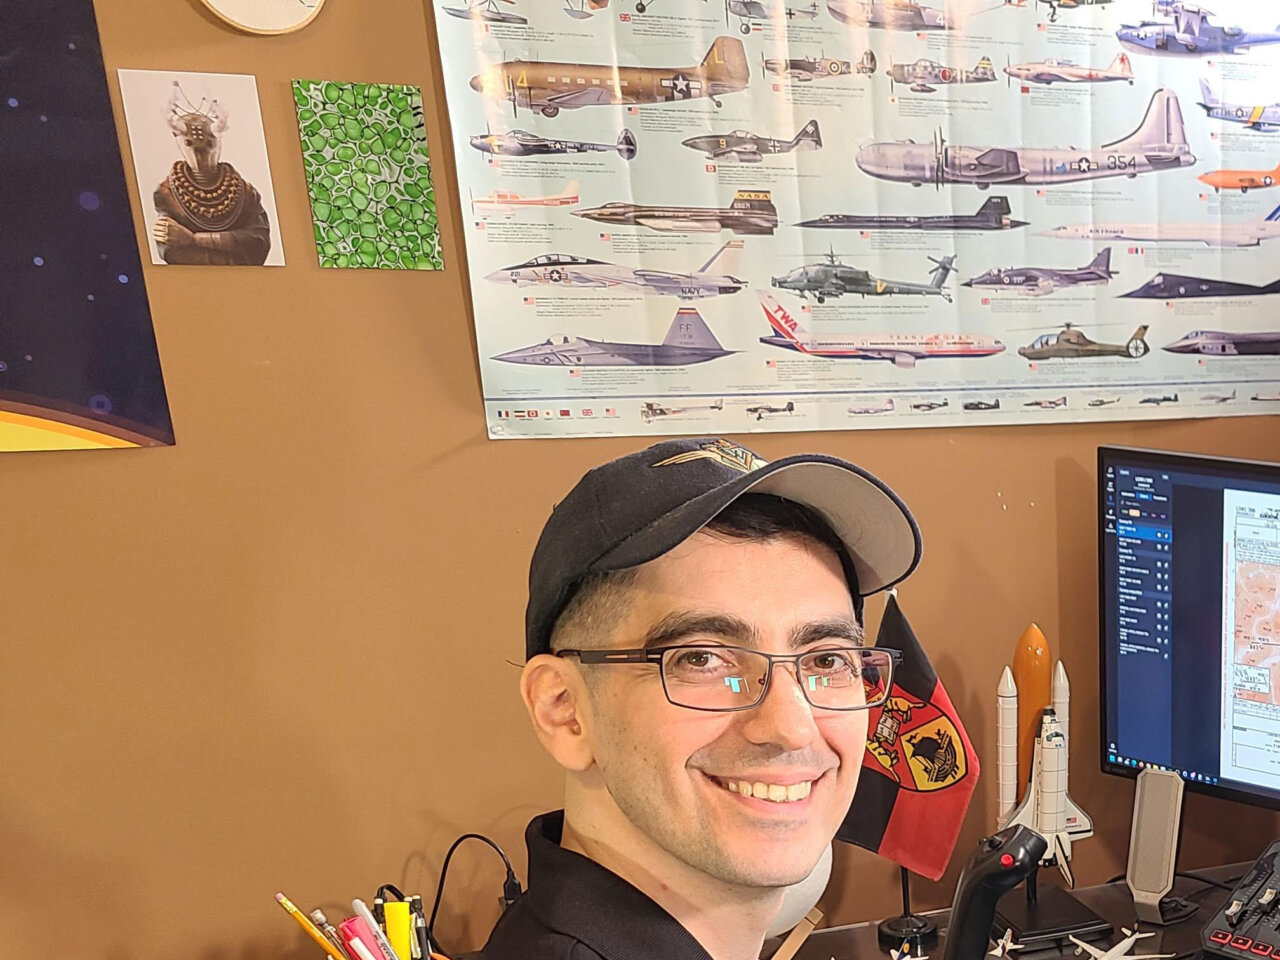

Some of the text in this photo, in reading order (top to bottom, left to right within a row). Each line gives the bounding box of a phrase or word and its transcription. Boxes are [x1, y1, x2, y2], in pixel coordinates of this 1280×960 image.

[1106, 155, 1137, 171] 354
[738, 191, 770, 199] NASA
[681, 287, 701, 296] NAVY
[773, 304, 799, 333] TWA
